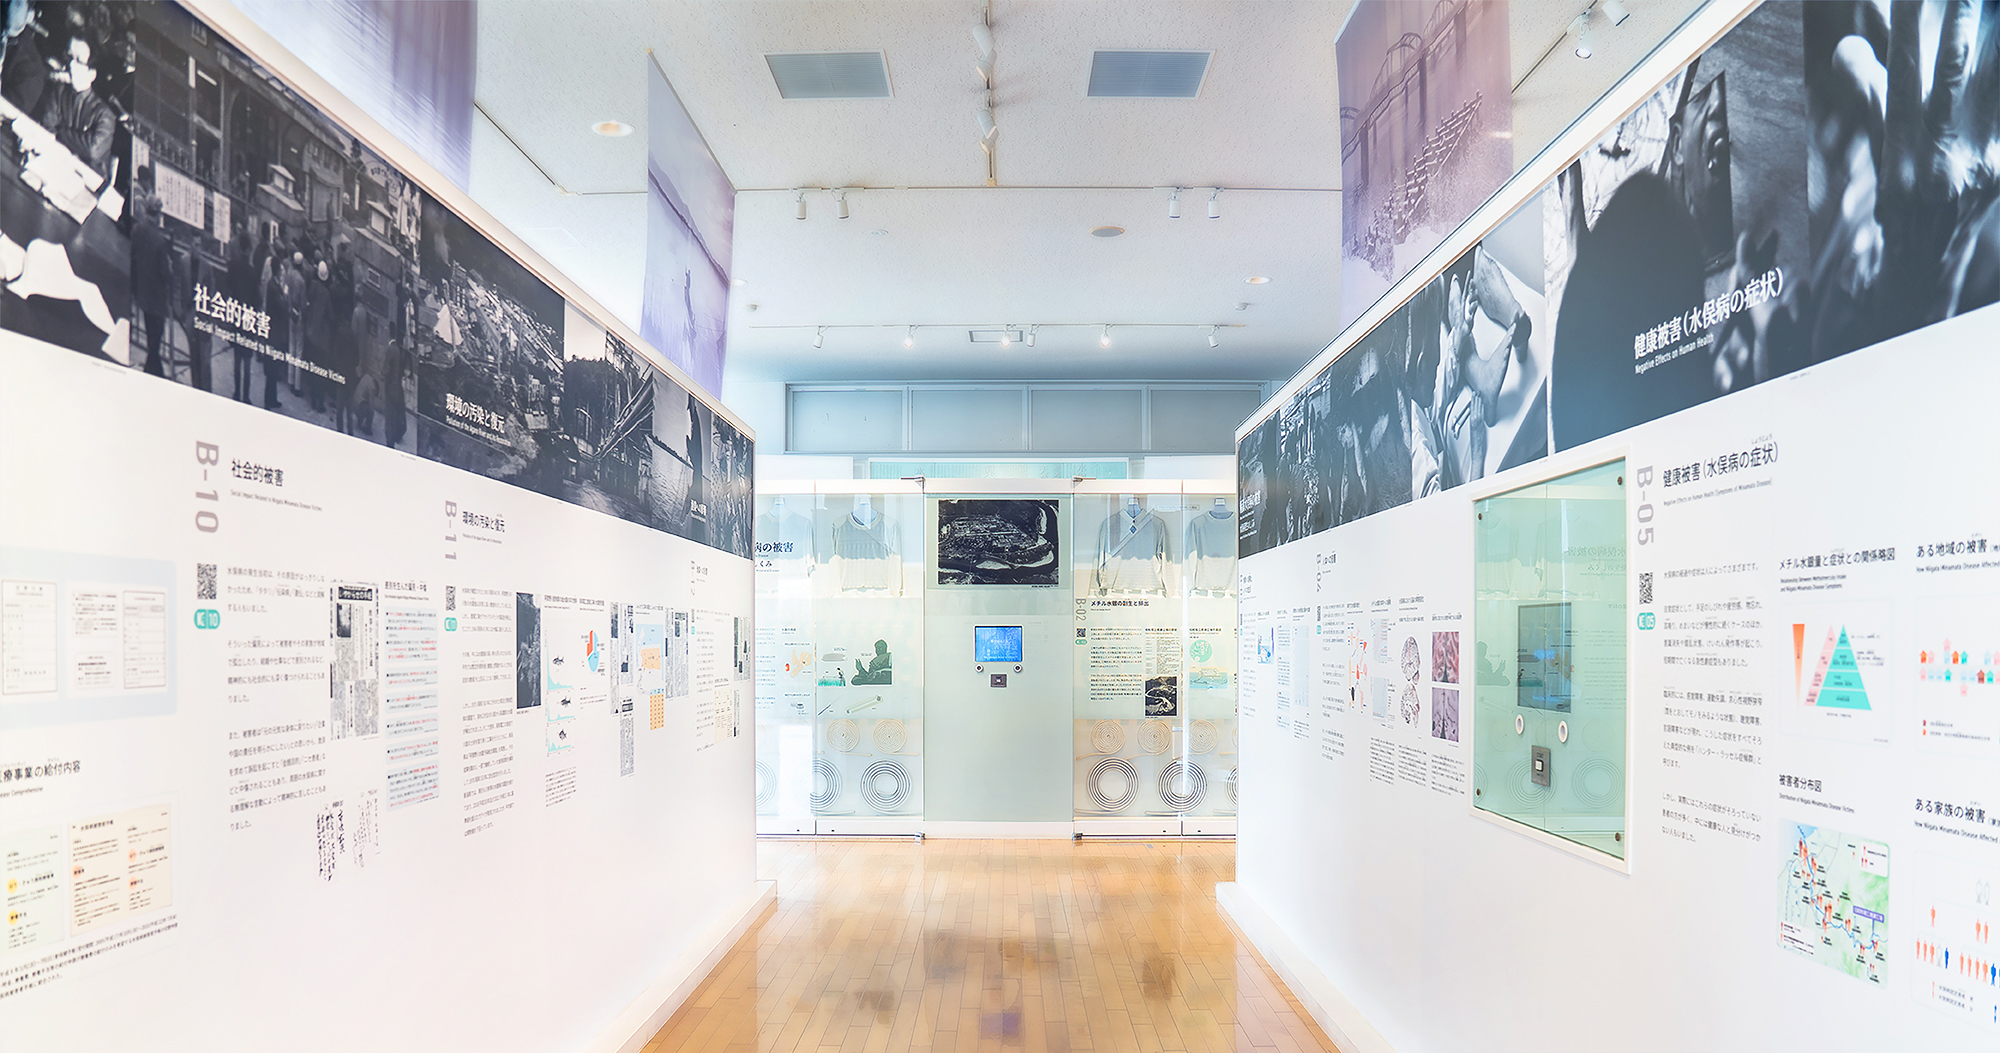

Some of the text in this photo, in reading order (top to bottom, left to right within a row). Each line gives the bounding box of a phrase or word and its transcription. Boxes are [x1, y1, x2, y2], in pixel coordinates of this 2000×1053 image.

[194, 282, 271, 339] 社会的被害
[1634, 267, 1783, 360] 健康被害（水俣病の症状）
[1635, 332, 1714, 374] Negative Effects on Human Health
[446, 393, 504, 434] 環境の汚染と復元
[232, 458, 284, 487] 社会的被害
[1663, 442, 1778, 488] 健康被害（水俣病の症状）
[196, 440, 219, 533] B-10
[1637, 466, 1654, 546] B-05
[445, 500, 457, 560] B-11
[1916, 539, 1987, 558] ある地域の被害
[209, 613, 218, 626] 10
[1076, 598, 1086, 620] B-02
[0, 760, 80, 782] 療事業の給付内容
[1779, 774, 1822, 792] 被害者分布図
[1915, 798, 1985, 823] ある家族の被害
